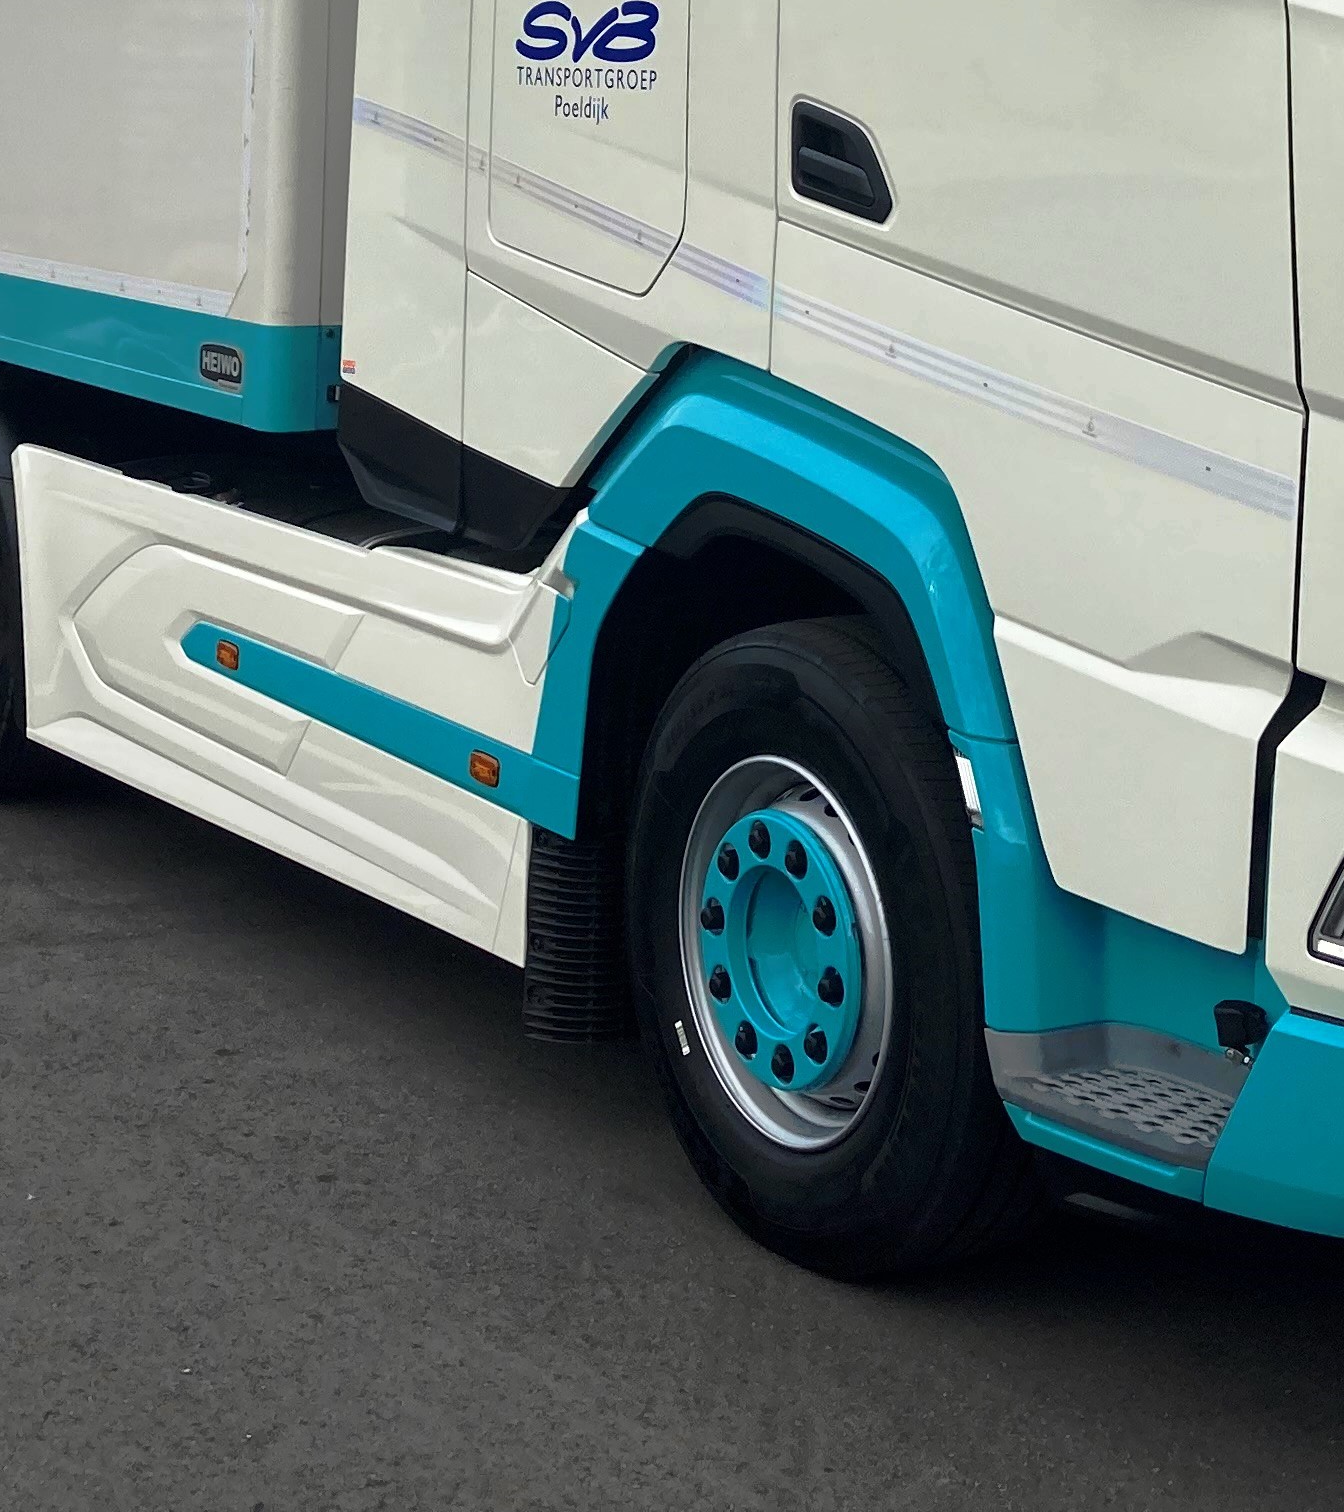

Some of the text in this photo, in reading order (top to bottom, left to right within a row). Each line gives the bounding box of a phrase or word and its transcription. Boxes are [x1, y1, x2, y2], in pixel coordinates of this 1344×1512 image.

[516, 0, 660, 63] SVB
[517, 66, 657, 91] TRANSPORTGROEP
[554, 94, 609, 126] Poeldijk
[202, 349, 240, 377] HEIWO
